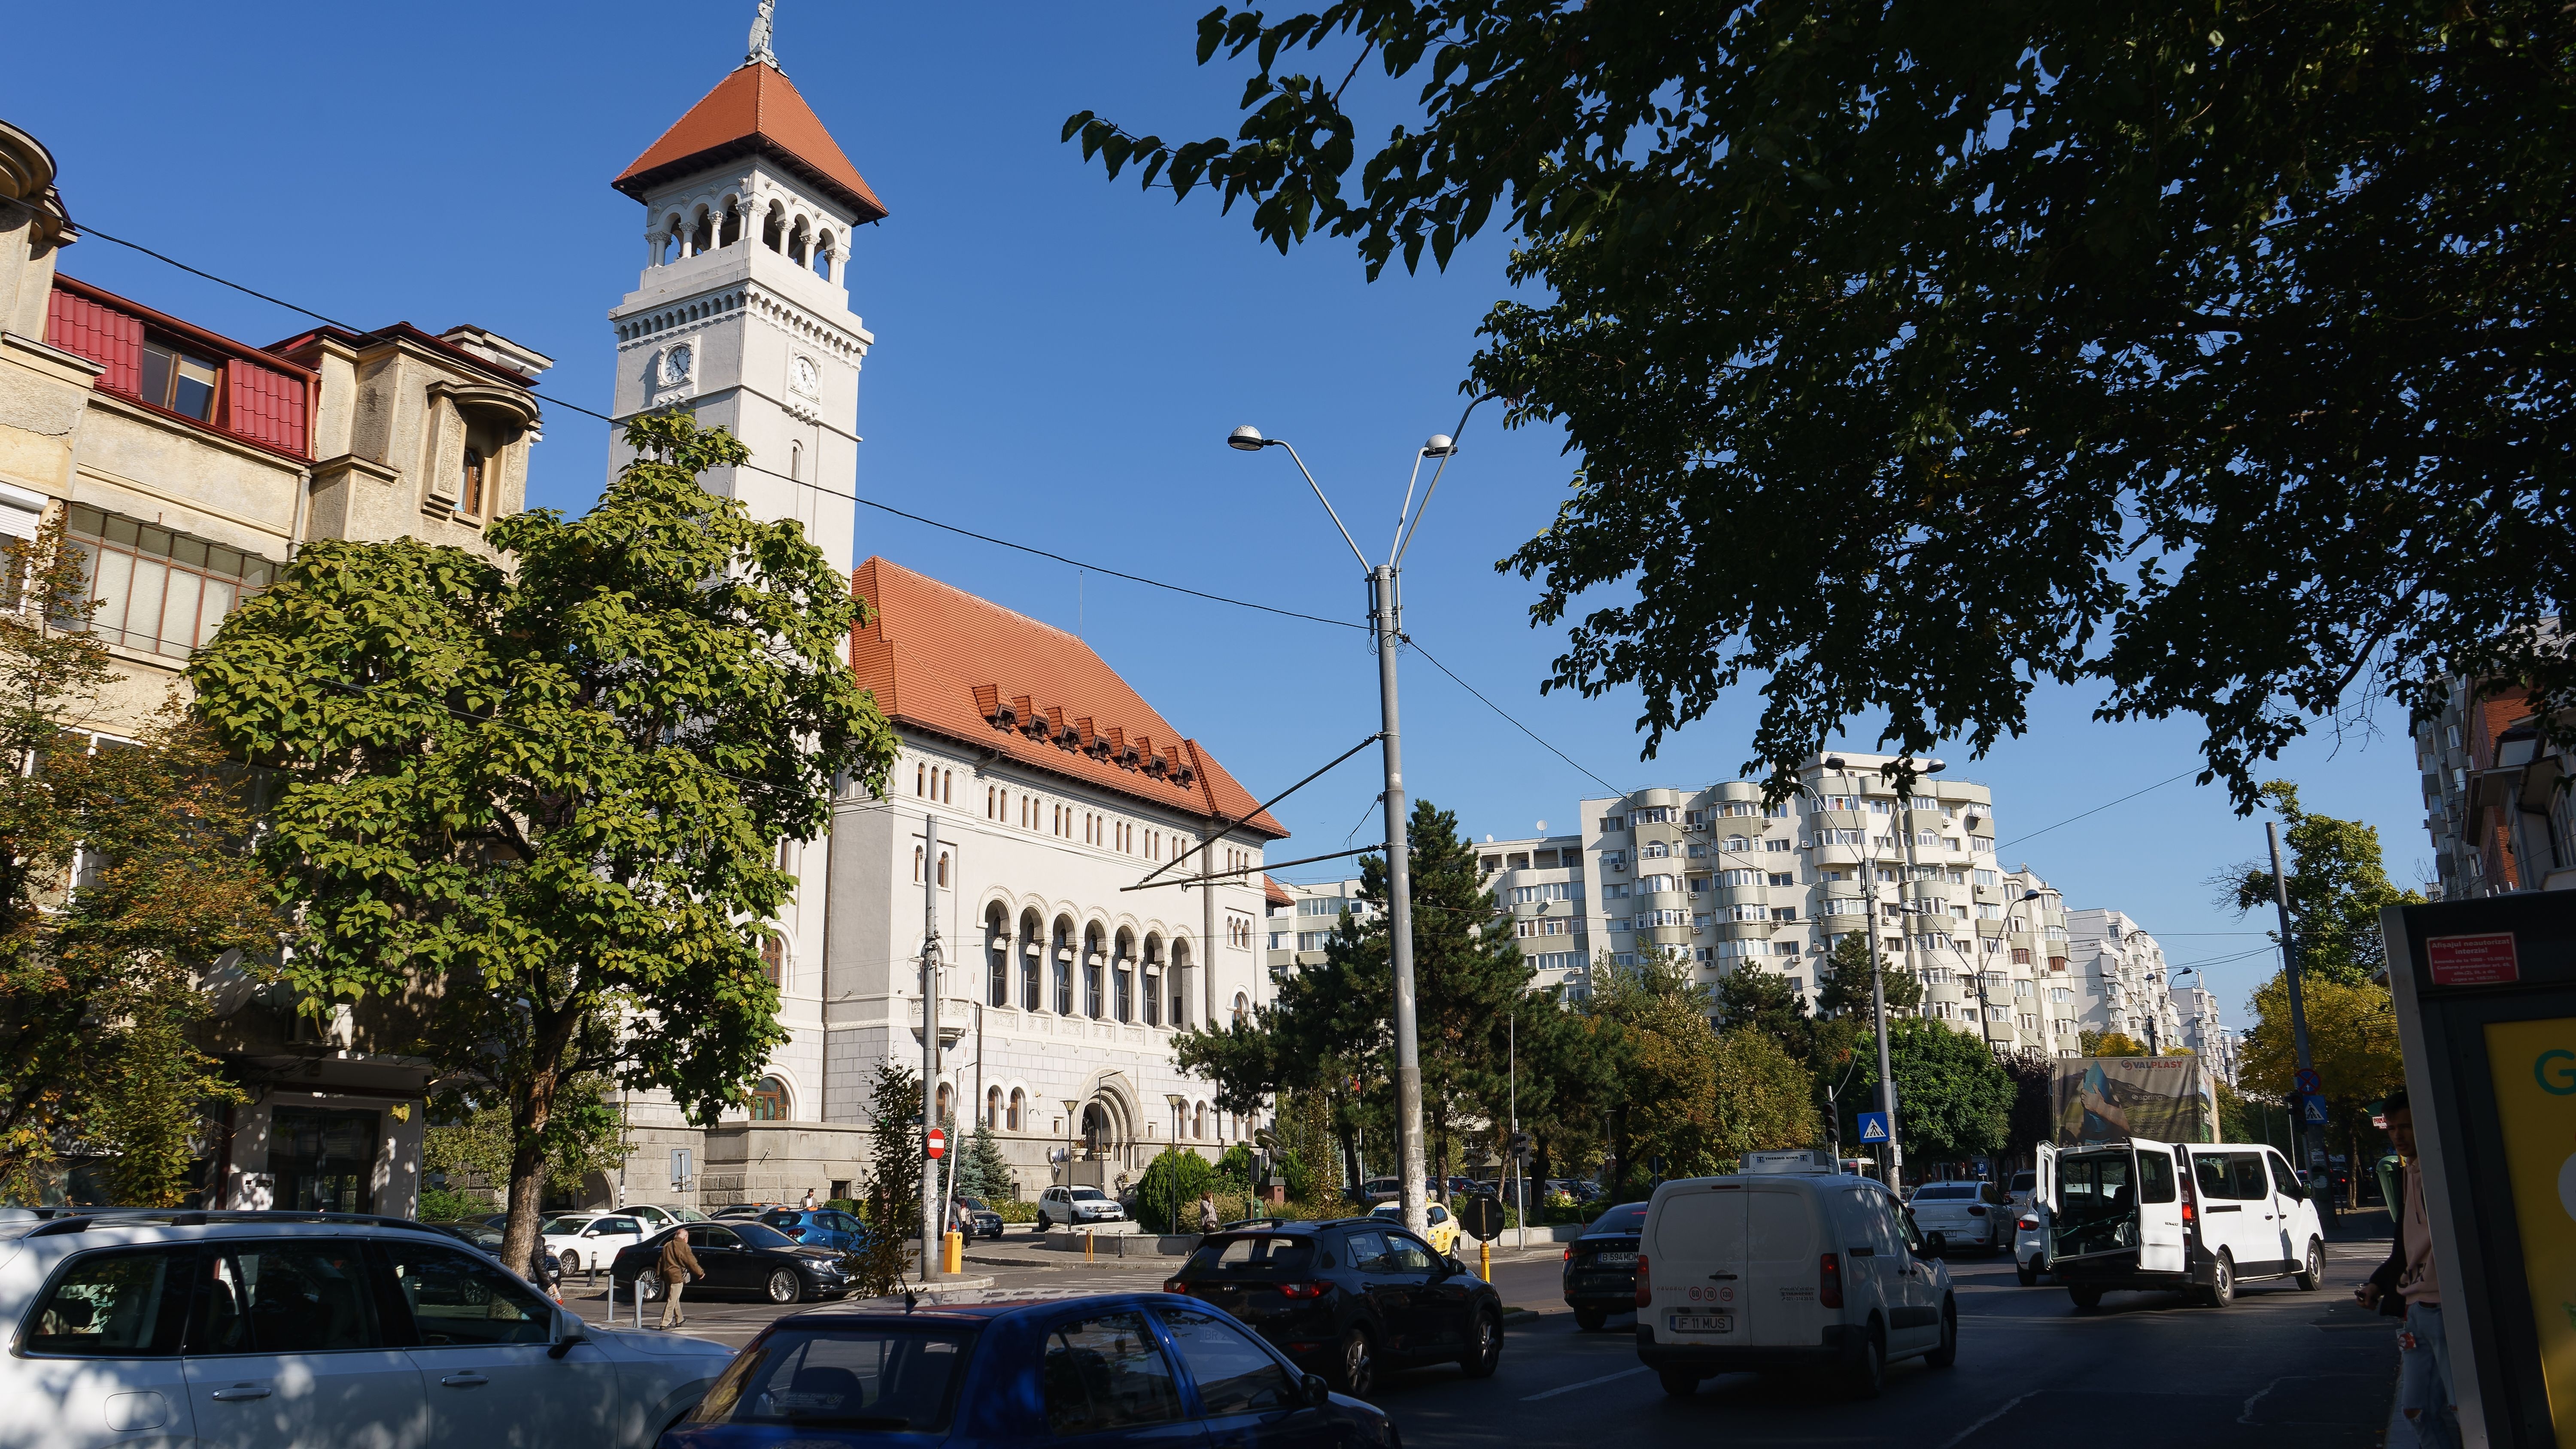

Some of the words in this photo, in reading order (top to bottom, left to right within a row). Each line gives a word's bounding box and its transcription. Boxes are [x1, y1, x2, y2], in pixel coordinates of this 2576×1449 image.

[2432, 941, 2461, 949] Afișajul
[1679, 1318, 1688, 1329] IF
[1692, 1318, 1699, 1329] 11
[1703, 1318, 1725, 1329] MUS
